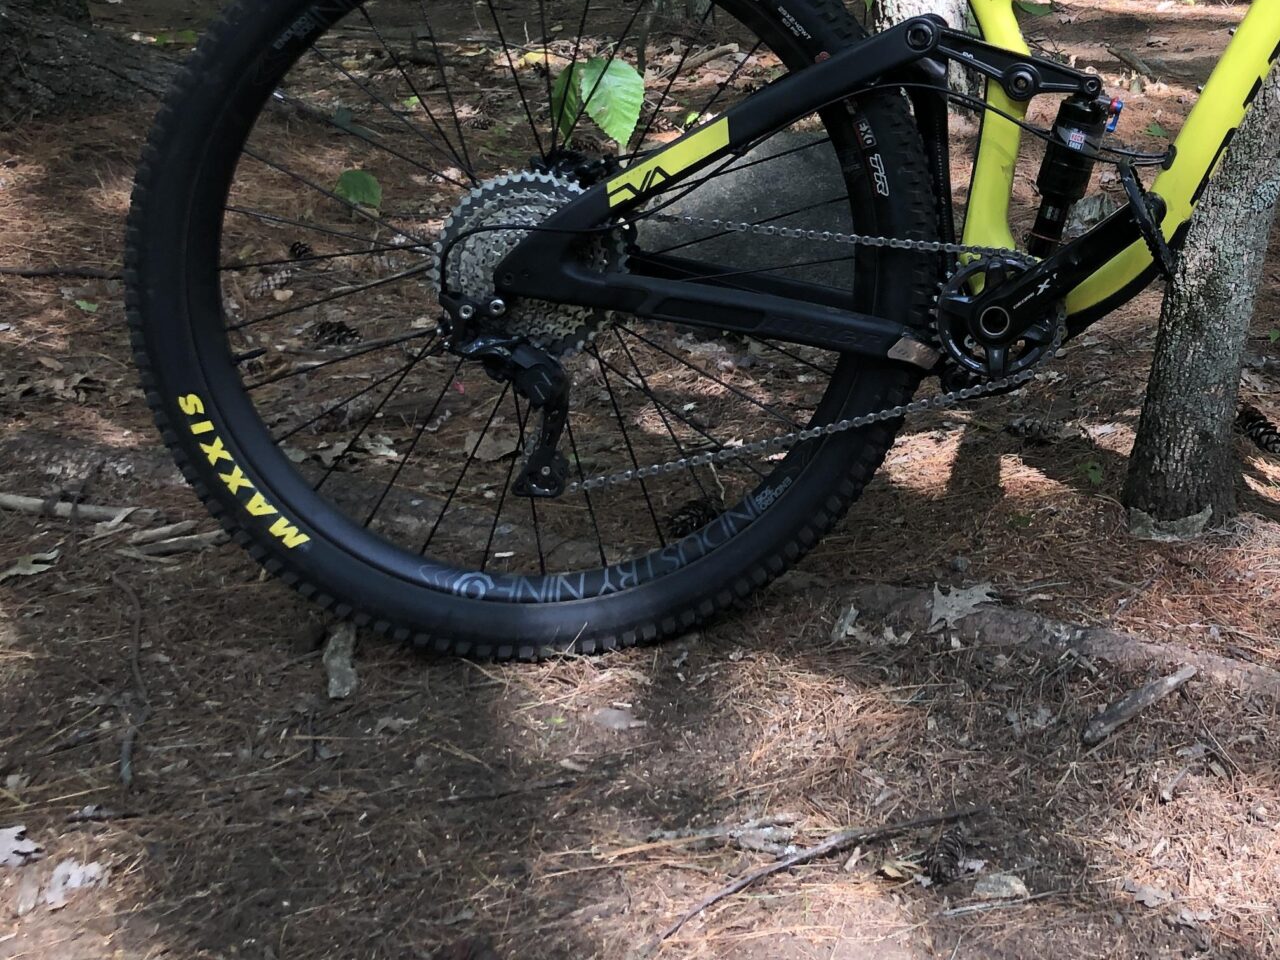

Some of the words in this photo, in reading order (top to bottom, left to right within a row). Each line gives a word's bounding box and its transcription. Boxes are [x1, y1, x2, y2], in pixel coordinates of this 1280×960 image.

[859, 120, 875, 147] EXO
[869, 153, 889, 197] TR
[178, 393, 311, 549] MAXXIS
[599, 491, 761, 595] INDUSTRY
[495, 573, 586, 604] NINE
